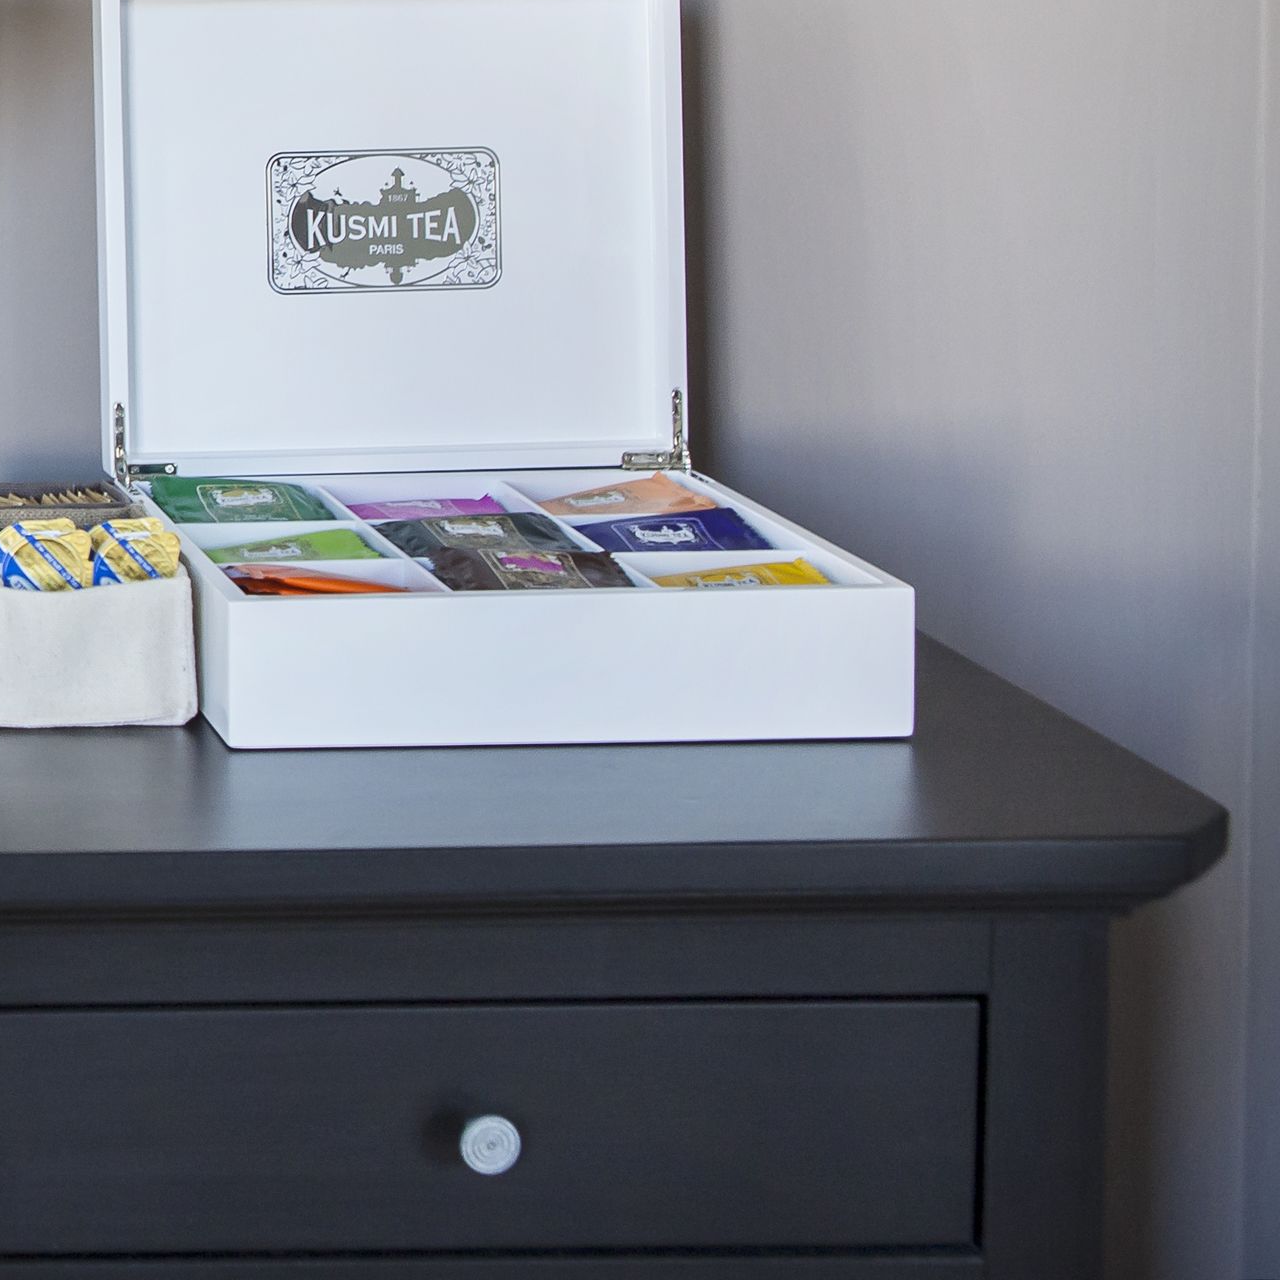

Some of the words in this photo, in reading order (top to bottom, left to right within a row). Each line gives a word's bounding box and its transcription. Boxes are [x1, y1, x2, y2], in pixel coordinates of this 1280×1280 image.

[306, 208, 397, 250] KUSMI
[406, 206, 461, 245] TEA
[369, 244, 404, 256] PARIS
